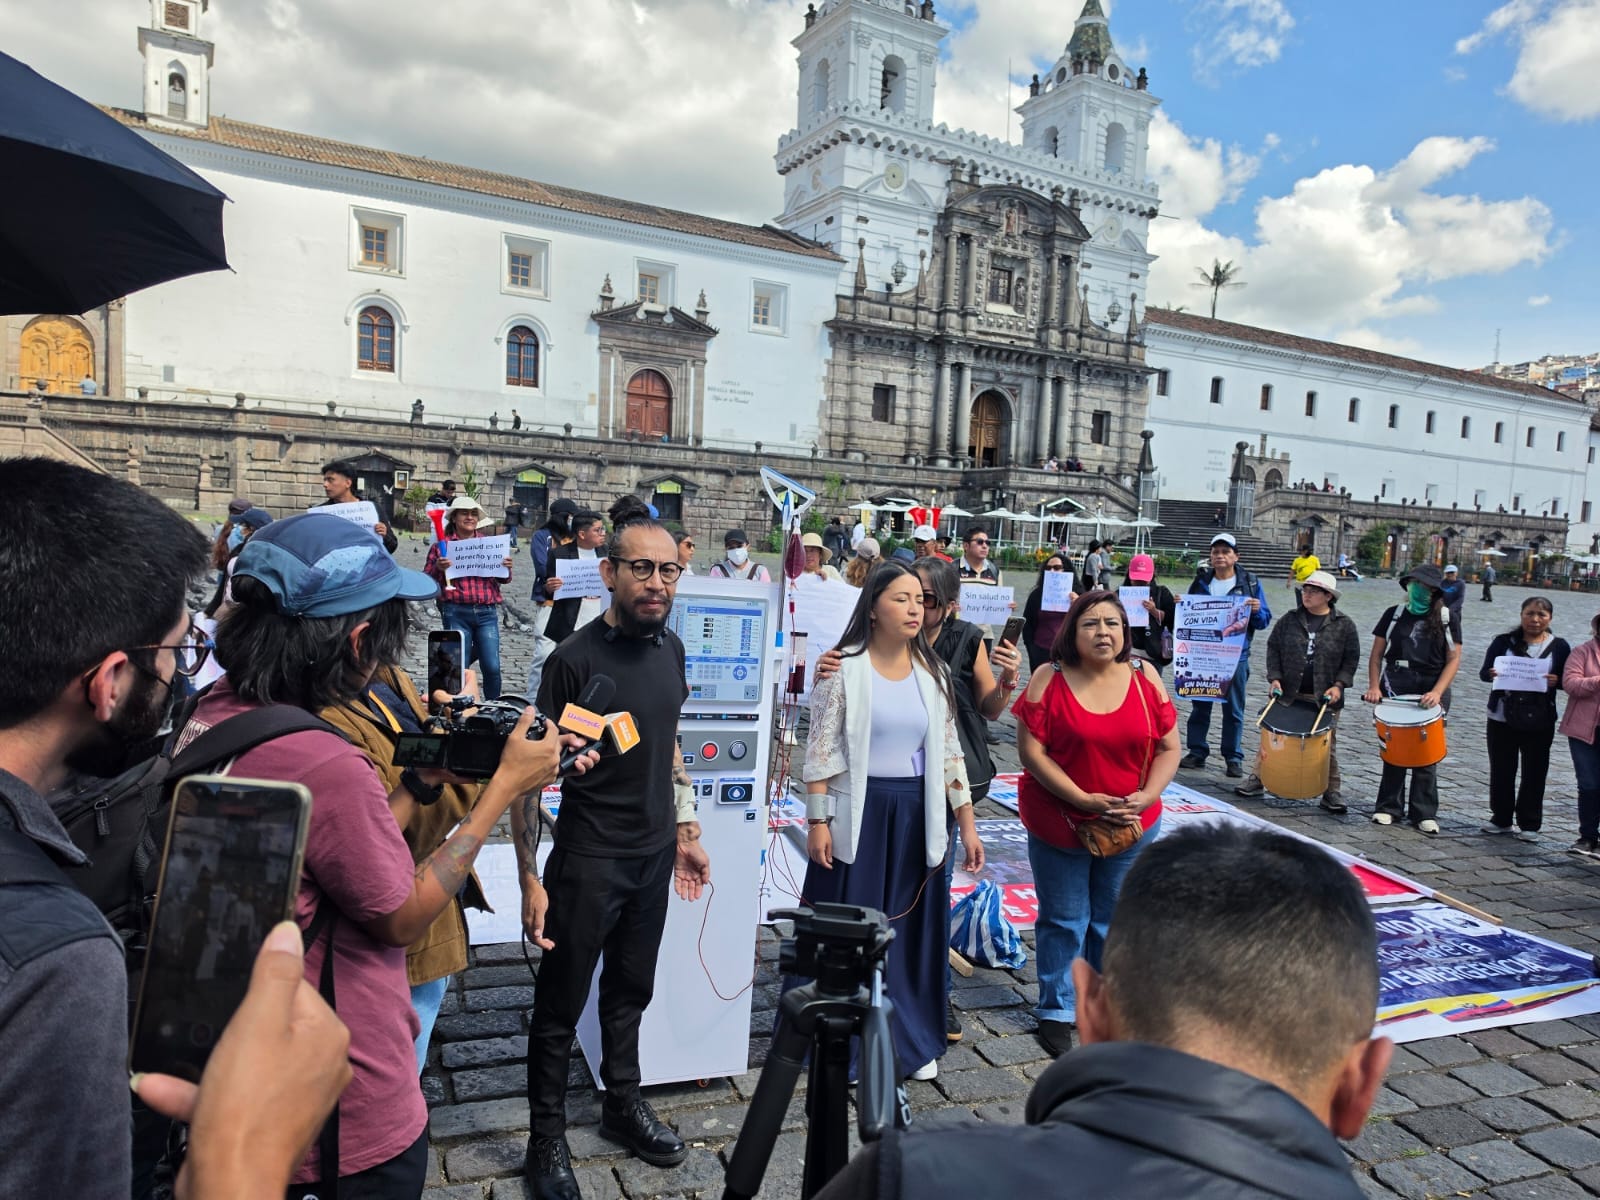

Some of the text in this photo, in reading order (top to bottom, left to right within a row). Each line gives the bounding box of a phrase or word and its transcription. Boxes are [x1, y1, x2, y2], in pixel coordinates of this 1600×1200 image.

[465, 543, 484, 551] salud
[455, 553, 485, 561] derecho
[466, 562, 501, 571] privilegio
[964, 591, 977, 600] Sin
[979, 592, 999, 601] salud
[966, 603, 980, 612] hay
[1183, 616, 1218, 626] CON VIDA
[1196, 680, 1220, 689] DIALISIS
[1178, 687, 1222, 695] NO HAY VIDA
[1460, 941, 1484, 954] la
[1389, 958, 1547, 987] EMERGENCIA
